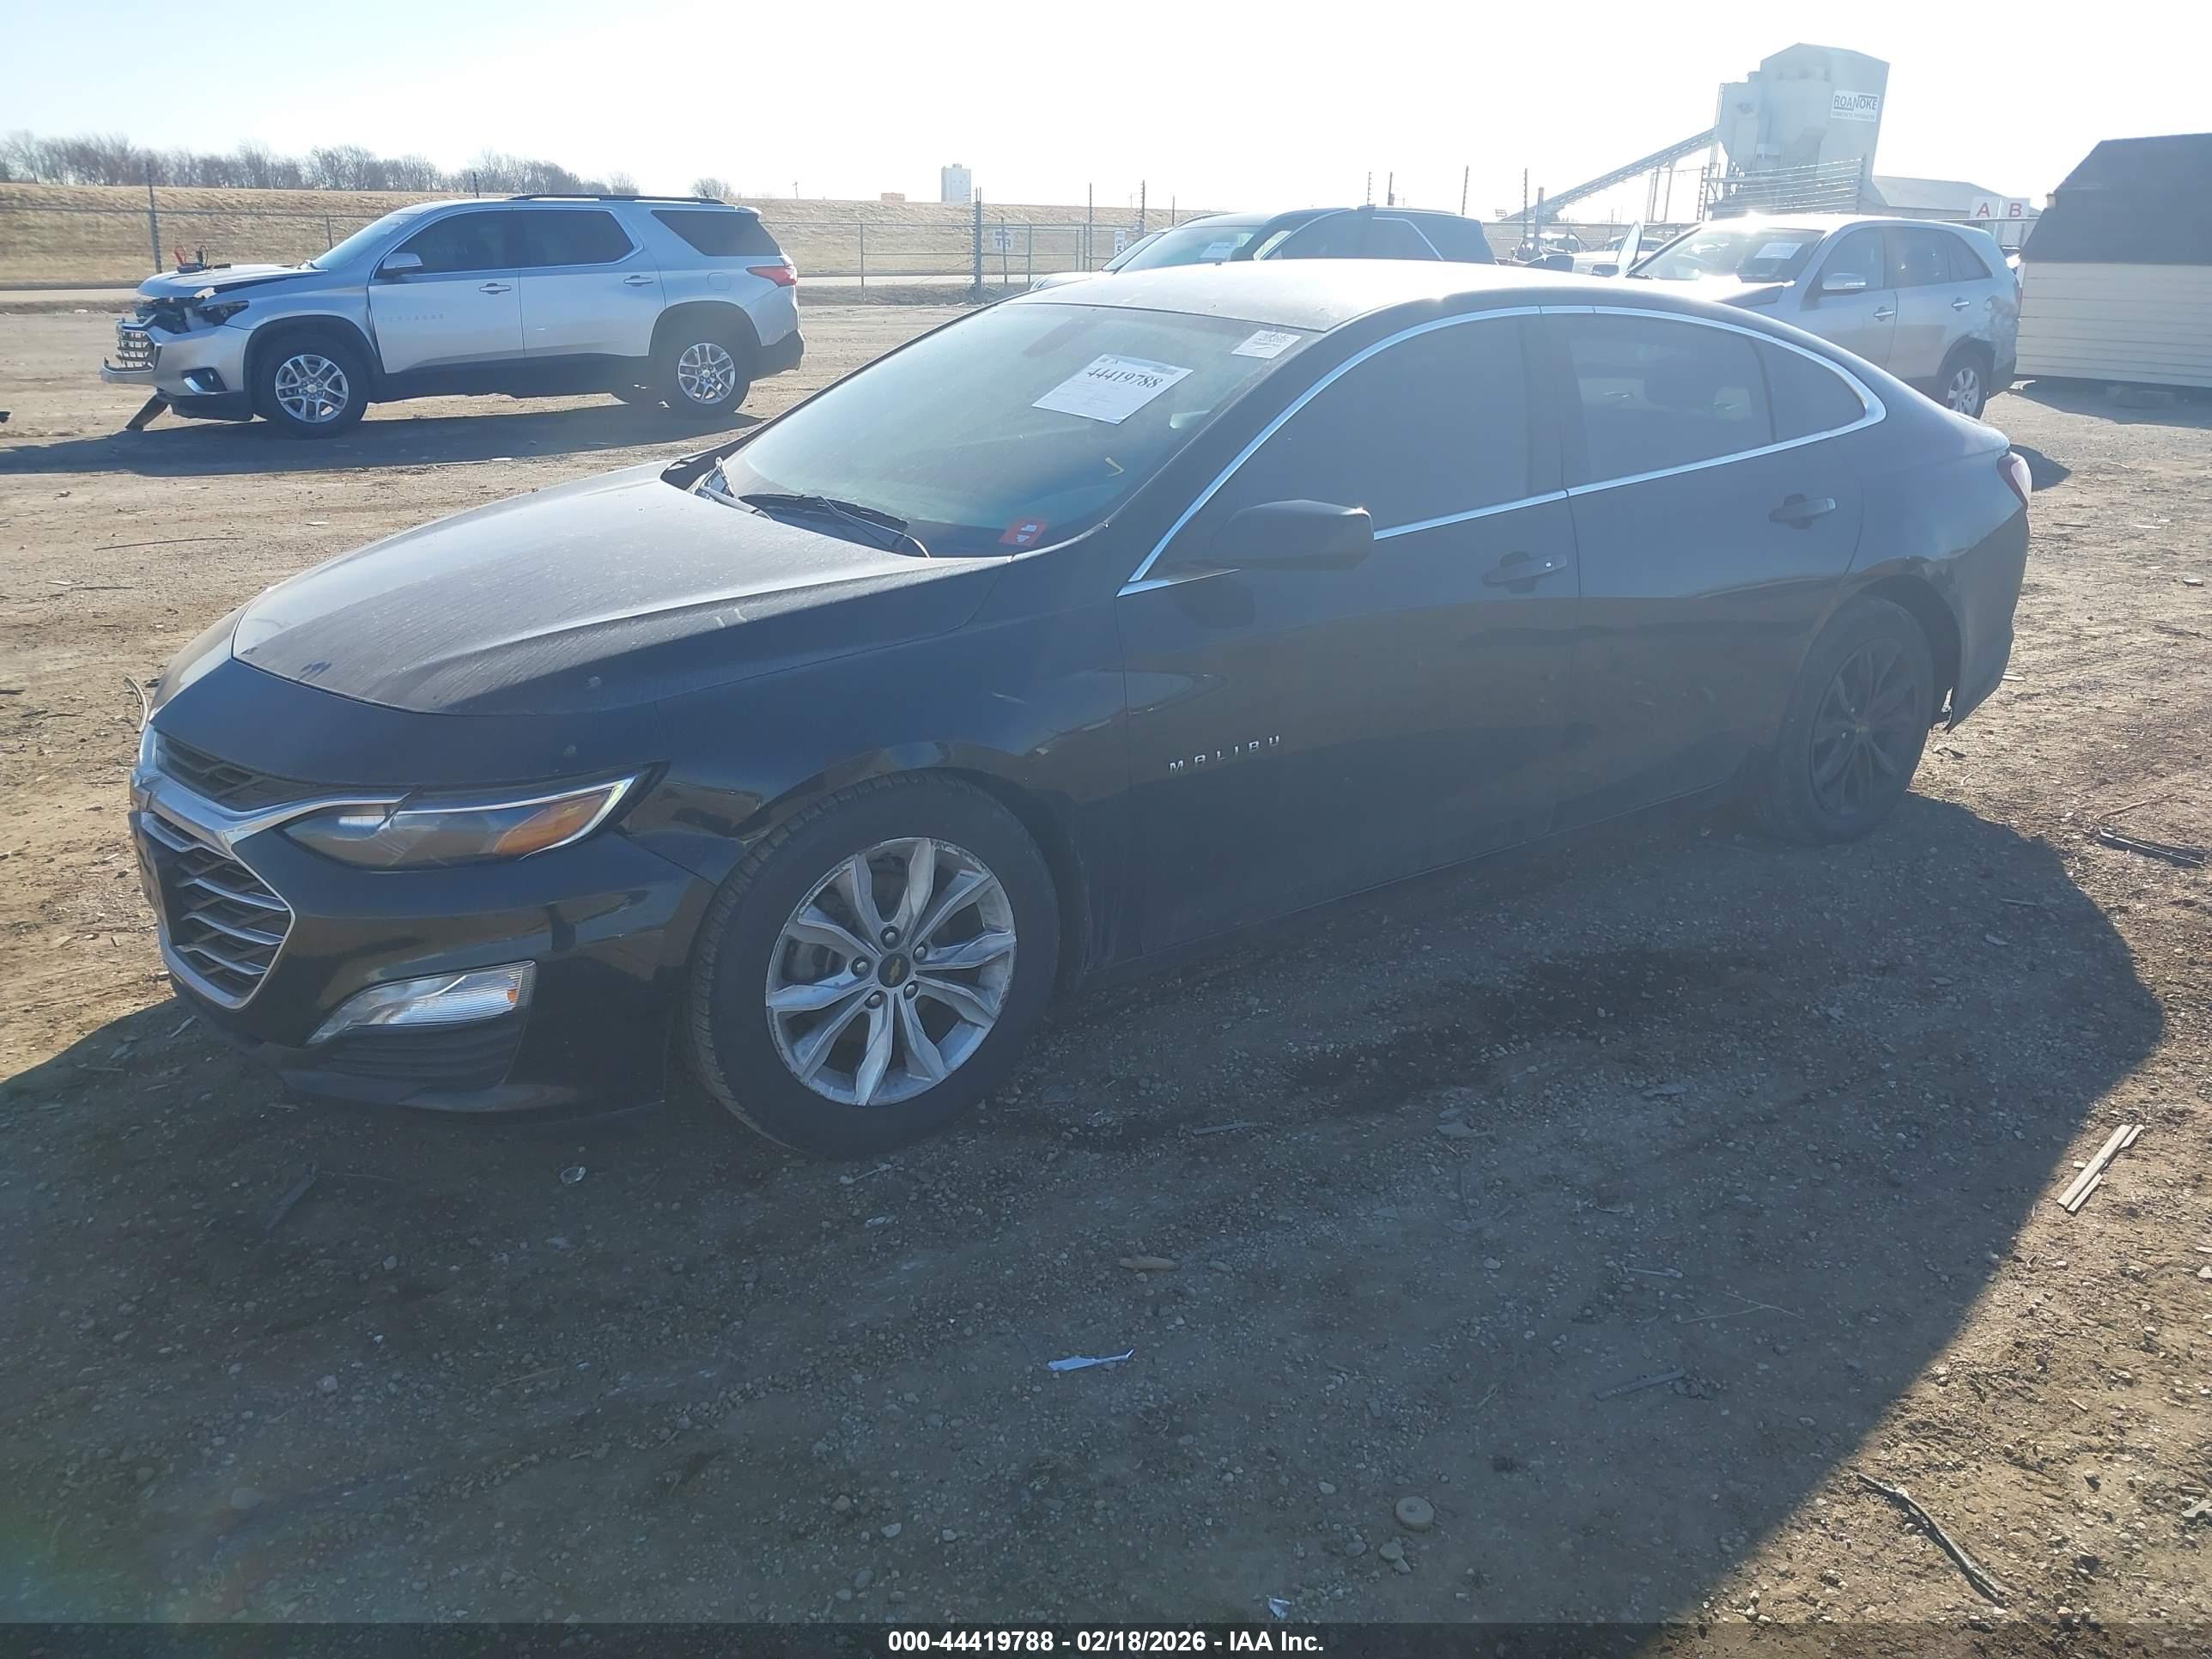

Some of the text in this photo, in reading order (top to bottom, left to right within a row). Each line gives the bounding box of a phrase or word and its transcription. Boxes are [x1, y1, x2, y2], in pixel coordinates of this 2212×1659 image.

[1833, 94, 1878, 111] ROANOKE
[1977, 202, 1990, 217] A
[2008, 203, 2021, 218] B
[1086, 367, 1164, 389] 44419788
[1169, 734, 1280, 772] MALIBU
